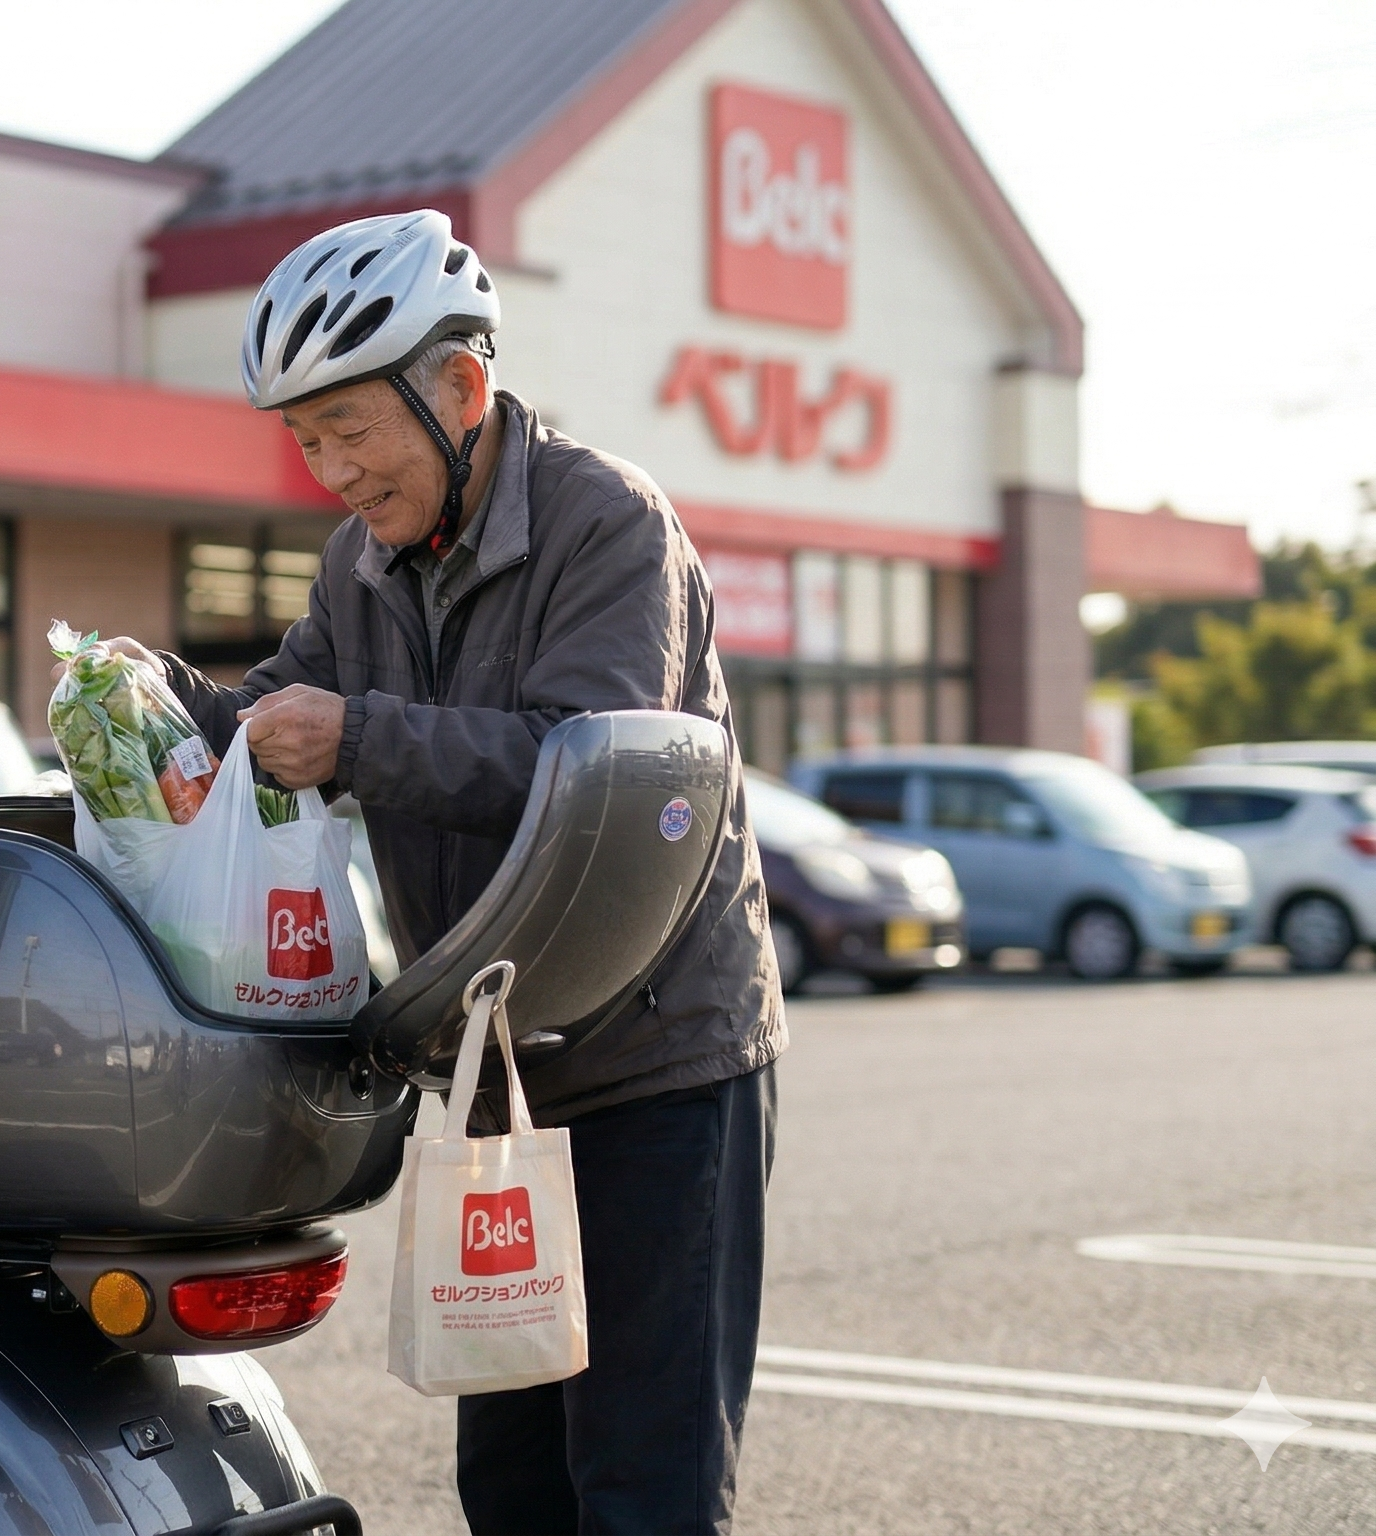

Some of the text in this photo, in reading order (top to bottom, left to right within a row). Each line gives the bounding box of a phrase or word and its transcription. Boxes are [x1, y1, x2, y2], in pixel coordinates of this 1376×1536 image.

[722, 126, 850, 267] Belc
[658, 344, 893, 474] ベルク
[466, 1205, 530, 1252] Belc
[430, 1274, 564, 1303] ゼルクションパック
